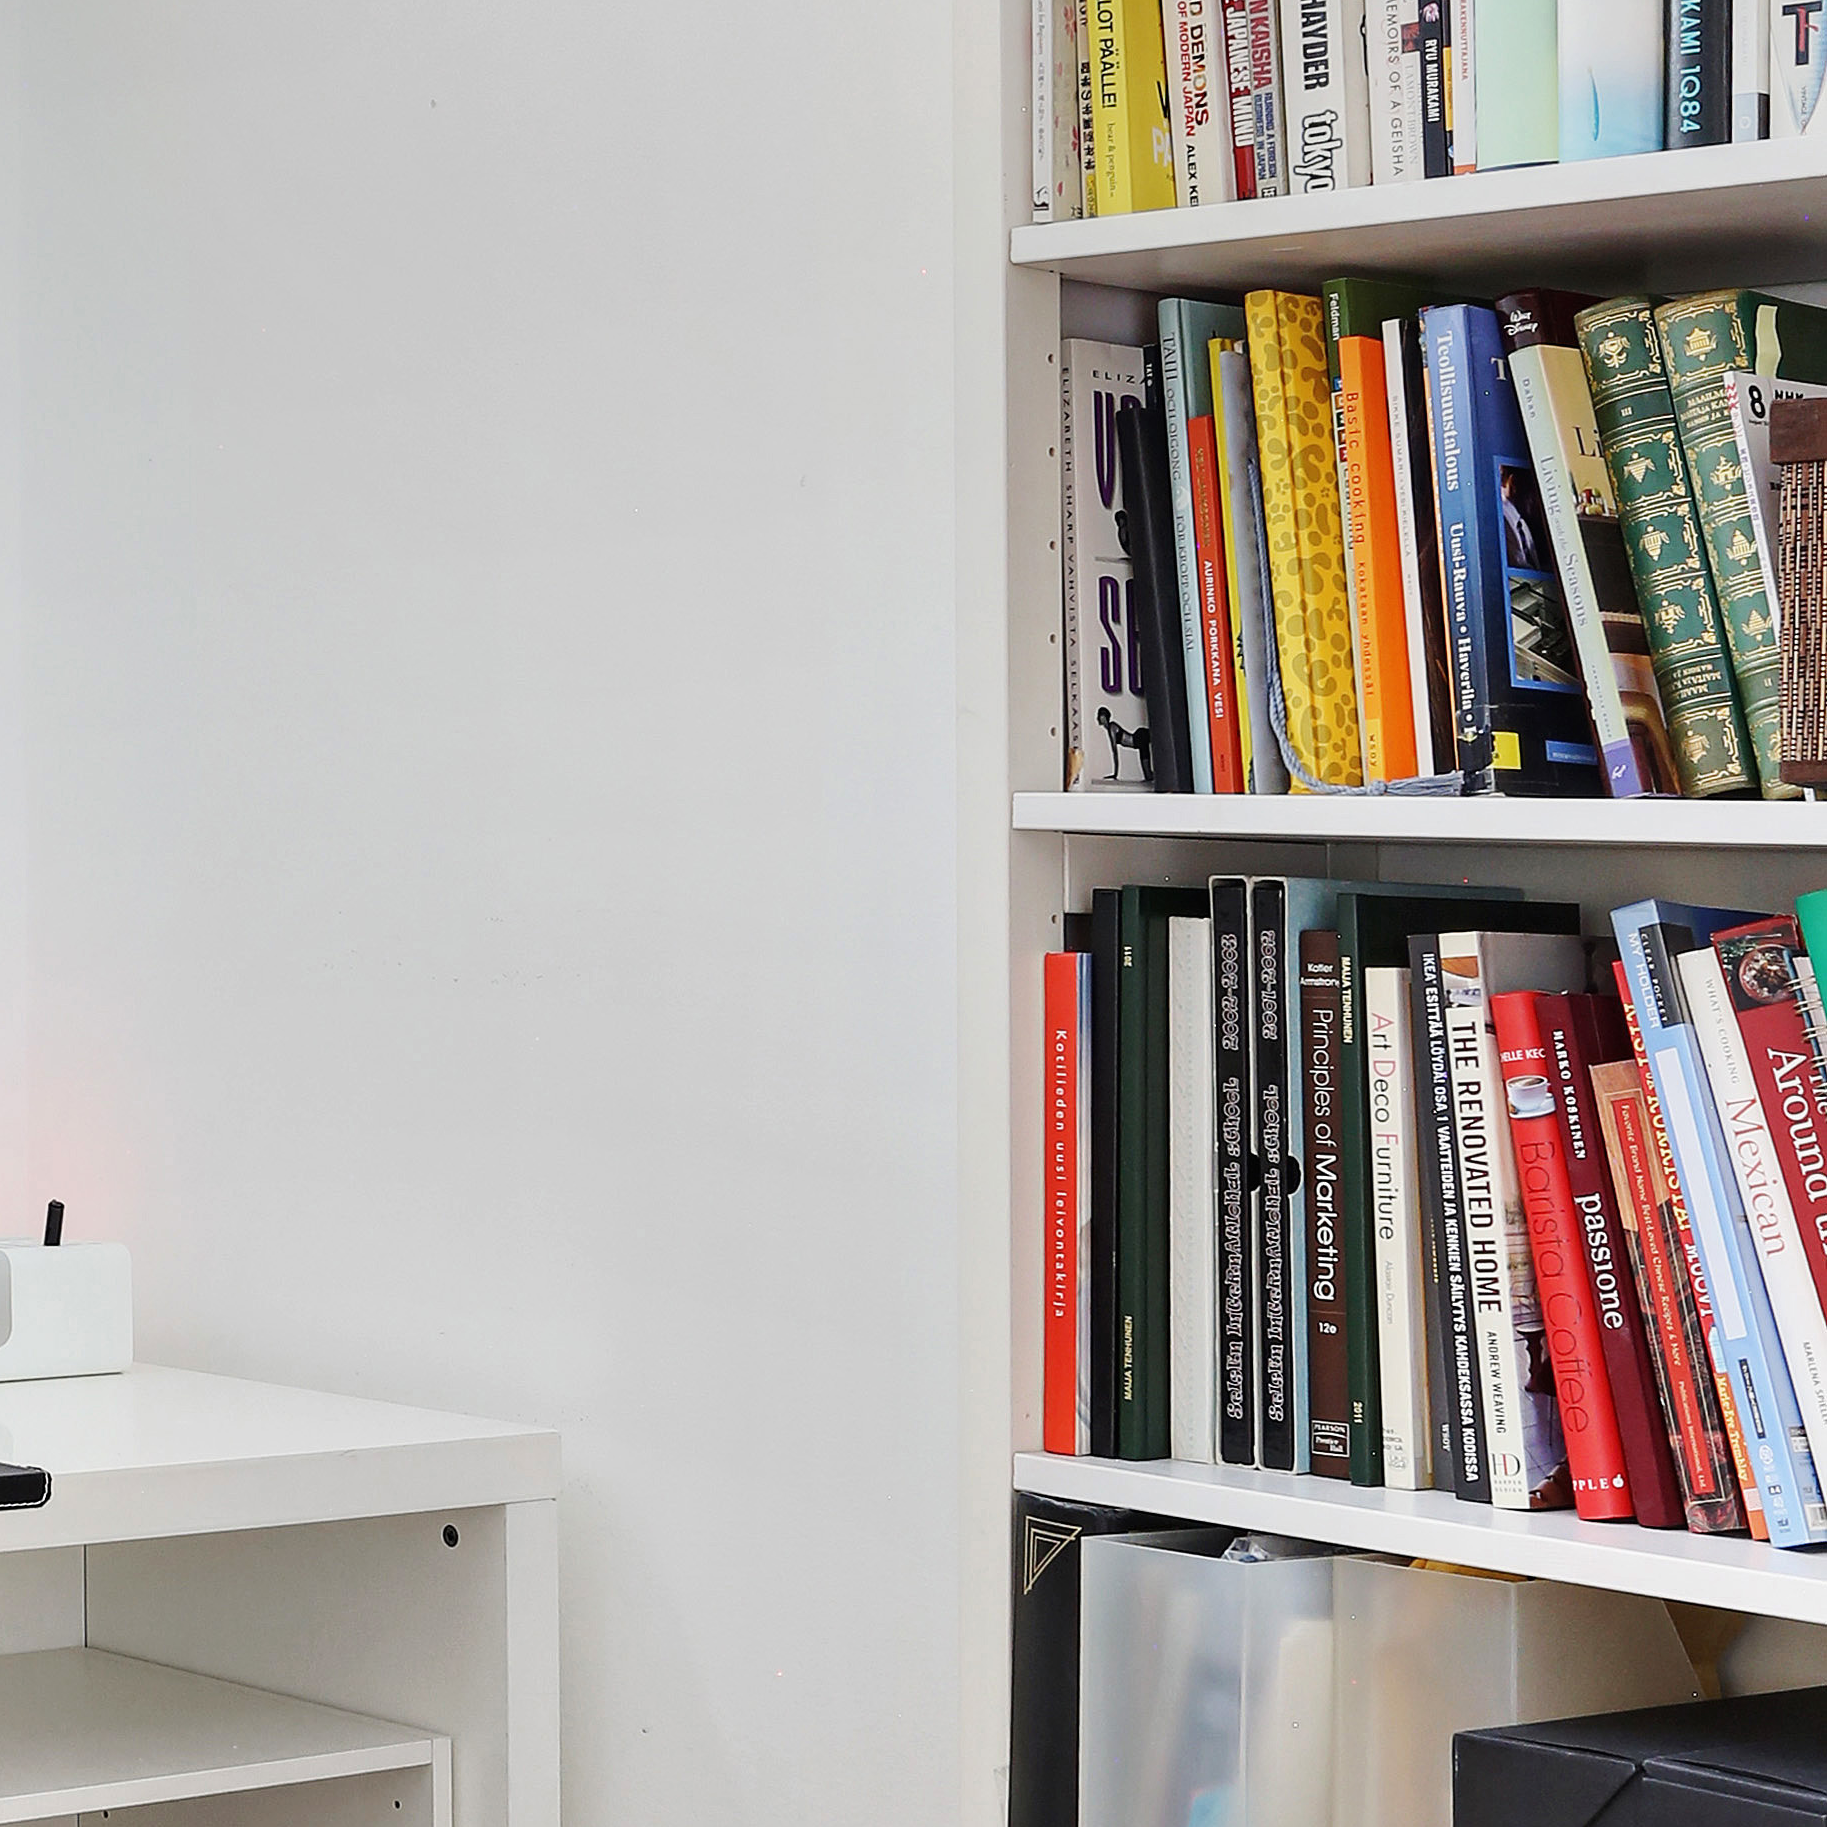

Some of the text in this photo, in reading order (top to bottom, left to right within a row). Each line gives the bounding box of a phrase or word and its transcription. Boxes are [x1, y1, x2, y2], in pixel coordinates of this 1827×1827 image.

[1098, 38, 1120, 110] PÄÄLLE!
[1180, 20, 1194, 82] MODERN
[1191, 24, 1210, 127] DEMONS
[1226, 6, 1251, 93] JAPANESE
[1251, 17, 1273, 91] KAISHA
[1425, 38, 1440, 123] RYU MURAKAMI
[1185, 85, 1197, 139] JAPAN
[1233, 96, 1255, 148] MIND
[1679, 64, 1701, 135] 1Q84
[1185, 143, 1198, 180] ALEX
[1293, 109, 1343, 194] tokyo
[1391, 119, 1406, 177] GEISHA
[1329, 292, 1342, 341] Feldman
[1503, 321, 1539, 336] Disney
[1522, 378, 1538, 419] Dahan
[1747, 385, 1767, 420] 8
[1061, 366, 1078, 647] ELIZABETH SHARP VAHVISTA
[1346, 391, 1368, 545] Basic cooking
[1435, 330, 1477, 711] Teollisuustalous Uusi-Rauva Haverila
[1538, 456, 1591, 627] Living Seasons
[1203, 559, 1225, 719] AURINKO PORKKANA VESI
[1221, 933, 1239, 1051] 2002-2003
[1261, 930, 1278, 1040] 2001-2002
[1628, 933, 1643, 957] MY
[1633, 963, 1661, 1030] HOLDER
[1553, 1030, 1573, 1080] MARKO
[1309, 1007, 1341, 1301] Principles of Marketing
[1371, 1012, 1399, 1241] Art Deco Furniture
[1451, 1021, 1503, 1314] THE RENOVATED HOME
[1765, 1047, 1827, 1203] Around
[1055, 1030, 1068, 1319] Kotilieden uusi leivontakirja
[1725, 1095, 1788, 1258] Mexican
[1425, 986, 1480, 1482] ESITTÄÄ LÖYDÄ! VAATTEIDEN JA KENKIEN SÄILYTYS KAHDEKSASSA KODISSA
[1574, 1192, 1625, 1330] passione
[1519, 1140, 1591, 1434] Barista Coffee
[1487, 1331, 1507, 1434] ANDREW WEAVING
